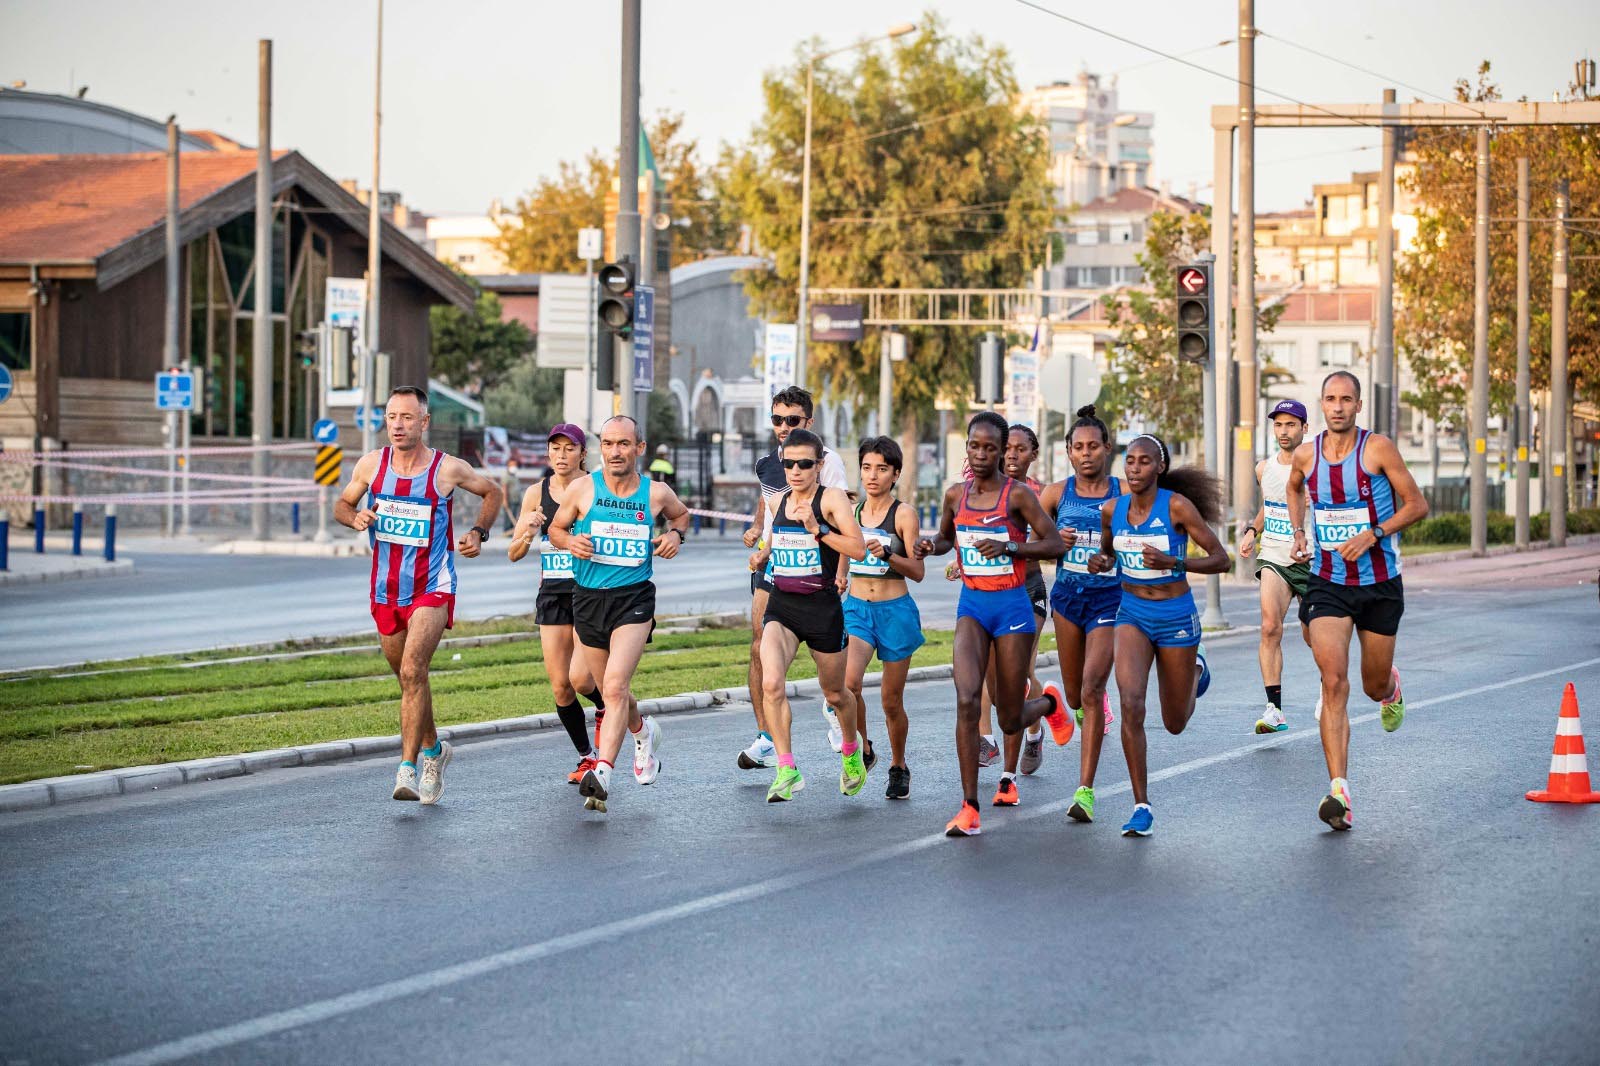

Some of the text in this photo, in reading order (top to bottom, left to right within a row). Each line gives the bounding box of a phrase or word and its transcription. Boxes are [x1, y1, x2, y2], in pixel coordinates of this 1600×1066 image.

[596, 496, 646, 511] AĞAOĞLU
[377, 516, 425, 537] 10271
[594, 538, 646, 557] 10153
[773, 550, 819, 566] 10182
